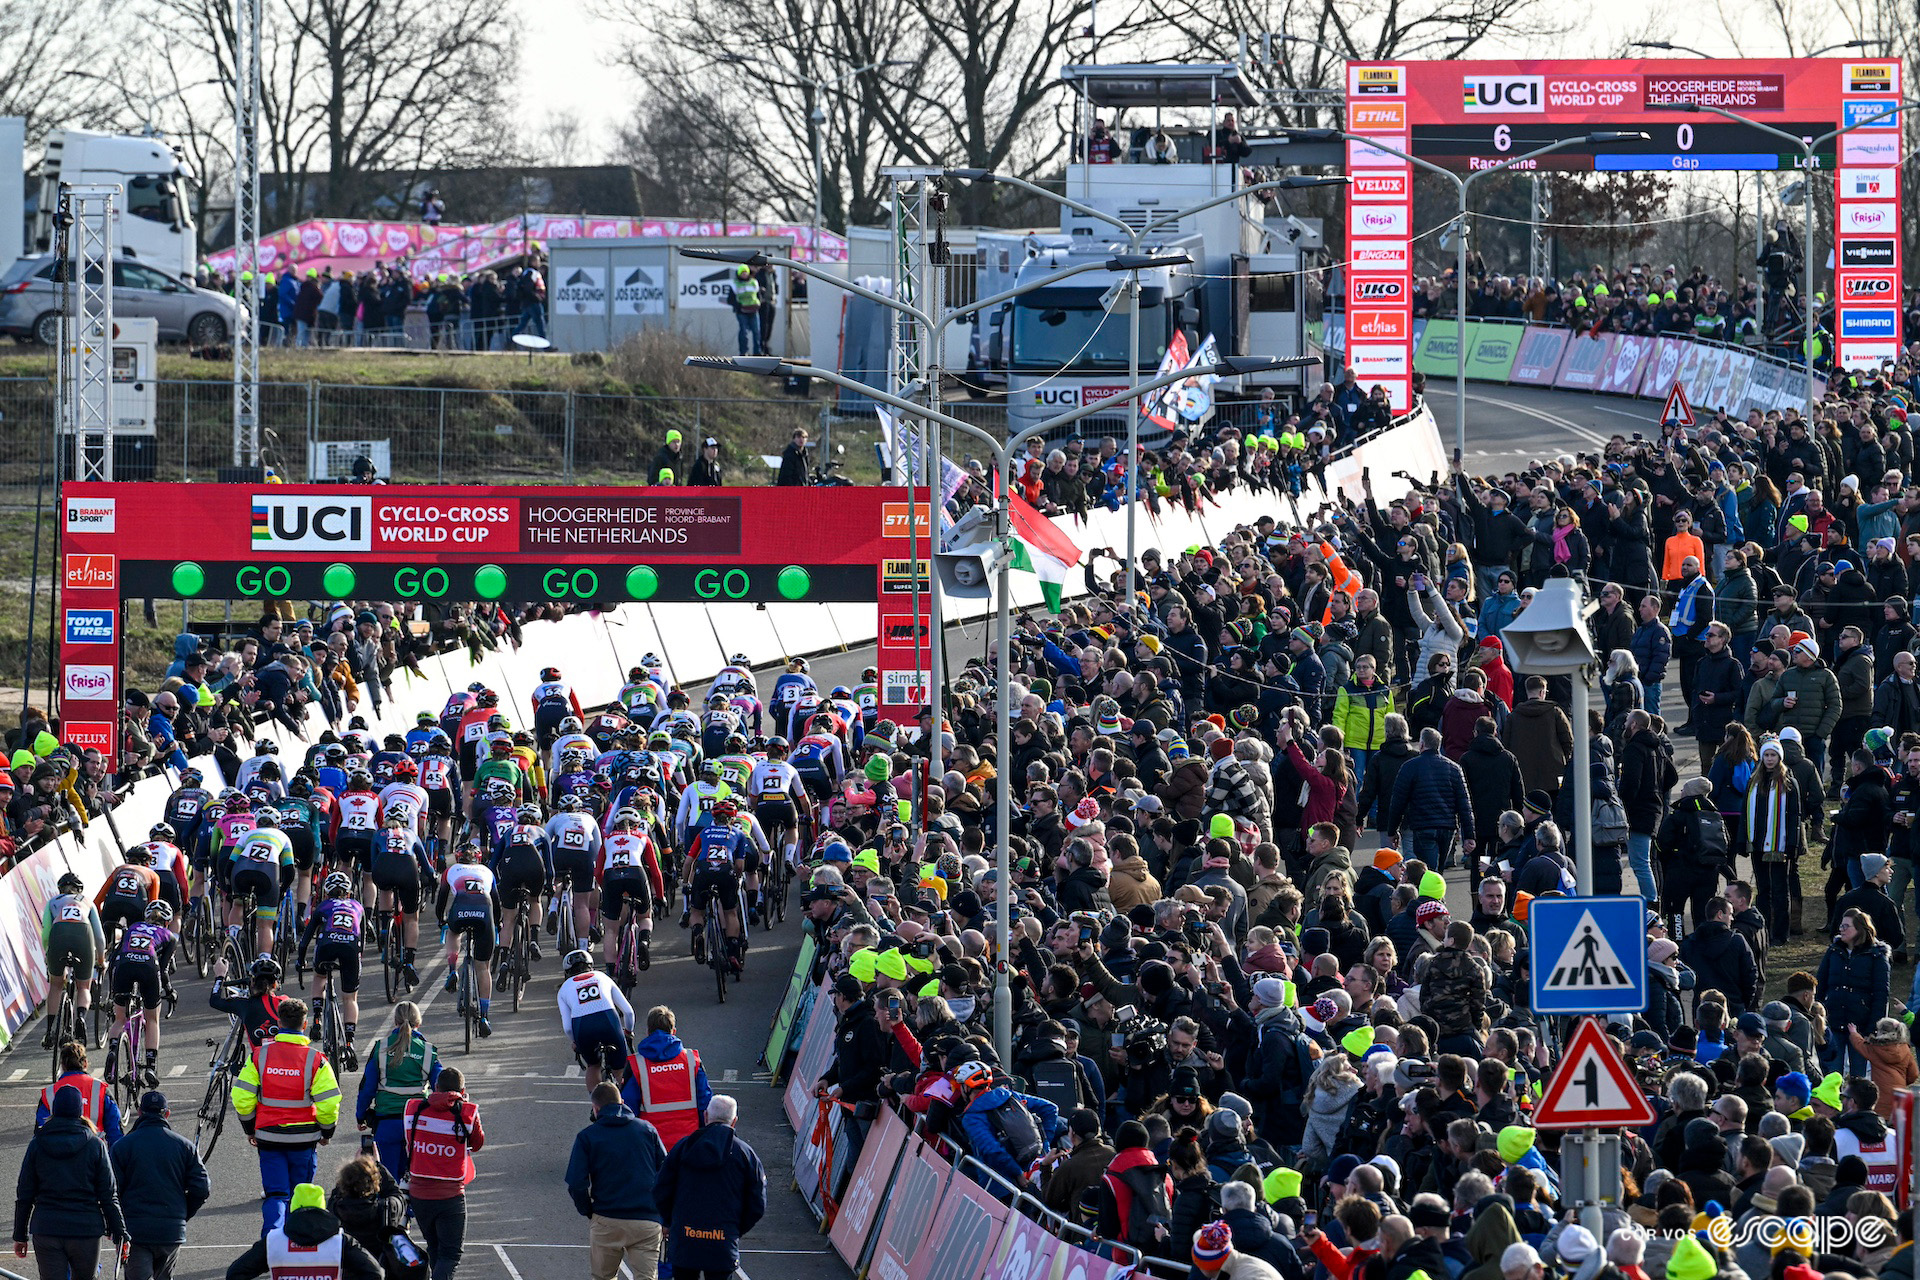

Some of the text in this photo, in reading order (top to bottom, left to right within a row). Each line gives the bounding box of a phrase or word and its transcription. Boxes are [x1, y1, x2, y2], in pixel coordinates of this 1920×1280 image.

[1856, 68, 1884, 78] FLANDRIEN
[1550, 81, 1636, 93] CYCLO-CROSS
[1650, 80, 1736, 93] HOOGERHEIDE
[1478, 82, 1538, 106] UCI
[1649, 94, 1756, 105] THE NETHERLANDS
[1550, 94, 1624, 106] WORLD CUP
[1848, 104, 1884, 114] TOYO
[1356, 110, 1400, 122] STIHL
[1494, 124, 1512, 151] 6
[1676, 124, 1694, 150] 0
[1470, 157, 1501, 170] Race
[1672, 157, 1699, 169] Gap
[1794, 156, 1820, 168] Left
[1357, 180, 1400, 191] VELUX
[1359, 250, 1400, 260] BINGOAL
[680, 284, 707, 296] JOS
[1364, 284, 1400, 294] IKO
[1854, 280, 1890, 290] IKO
[557, 288, 571, 300] JOS
[615, 288, 628, 300] JOS
[1361, 313, 1397, 335] ethias
[1846, 319, 1891, 328] SHIMANO
[1043, 390, 1078, 404] UCI
[379, 506, 510, 523] CYCLO-CROSS
[529, 506, 657, 523] HOOGERHEIDE
[273, 506, 361, 541] UCI
[379, 527, 490, 542] WORLD CUP
[528, 528, 688, 544] THE NETHERLANDS
[68, 557, 113, 585] ethias
[887, 562, 926, 574] FLANDEN
[236, 566, 292, 596] GO
[394, 567, 449, 597] GO
[542, 568, 599, 598] GO
[694, 569, 750, 599] GO
[68, 617, 104, 626] TOYO
[73, 627, 112, 636] TIRES
[890, 625, 928, 636] IKO
[888, 672, 926, 684] simac
[788, 690, 794, 698] 3
[863, 695, 871, 704] 6
[470, 727, 483, 736] 31
[68, 734, 108, 744] VELUX
[411, 745, 427, 753] 28
[376, 765, 393, 777] 34
[723, 770, 736, 780] 17
[426, 774, 442, 782] 45
[764, 778, 780, 787] 41
[250, 790, 267, 800] 36
[180, 802, 196, 812] 47
[210, 809, 225, 818] 12
[282, 811, 298, 819] 56
[349, 816, 365, 826] 42
[232, 825, 249, 835] 49
[513, 834, 528, 842] 51
[564, 835, 584, 846] 50
[388, 840, 405, 848] 52
[250, 847, 270, 858] 72
[708, 848, 727, 860] 24
[613, 854, 629, 865] 44
[118, 878, 138, 890] 63
[466, 880, 482, 891] 71
[63, 908, 81, 917] 73
[458, 911, 485, 919] SLOVAKIA
[334, 914, 352, 927] 25
[130, 938, 151, 948] 37
[578, 986, 600, 1001] 60
[266, 1067, 300, 1076] DOCTOR
[651, 1062, 685, 1074] DOCTOR
[684, 1225, 725, 1240] TeamNL
